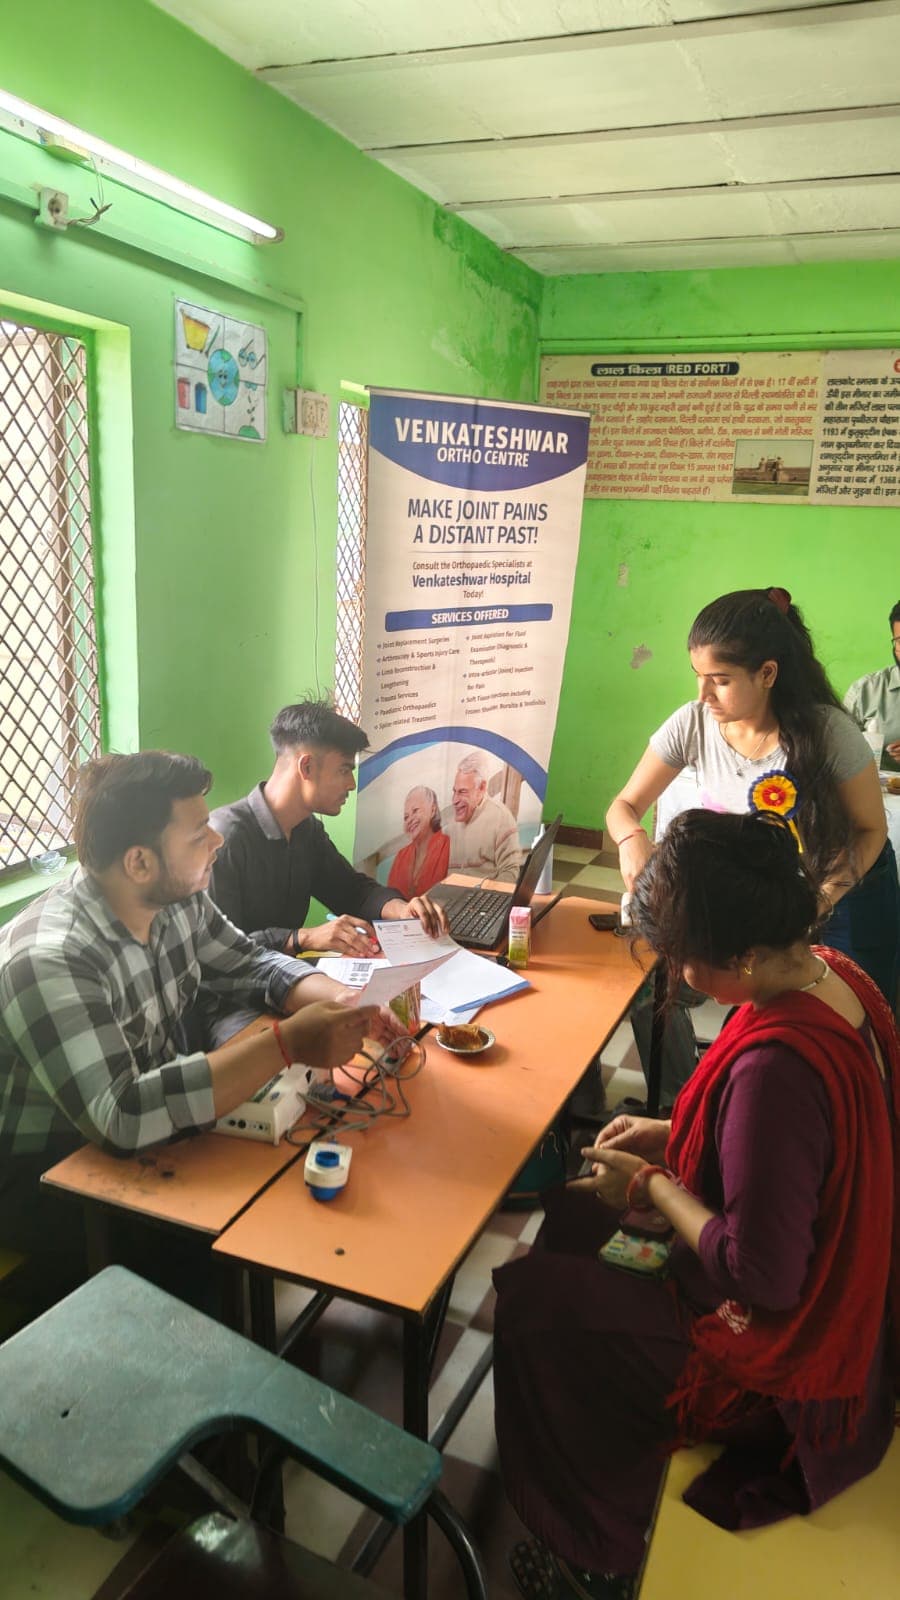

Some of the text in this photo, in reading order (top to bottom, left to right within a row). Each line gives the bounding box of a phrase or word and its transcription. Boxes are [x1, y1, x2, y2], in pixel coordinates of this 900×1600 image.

[597, 362, 730, 376] लाल किला (RED FORT)
[395, 417, 569, 454] VENKATESHWAR
[437, 447, 530, 468] ORTHO CENTRE
[408, 499, 548, 522] MAKE JOINT PAINS
[413, 524, 538, 544] A DISTANT PAST!
[412, 561, 440, 570] Consult
[440, 561, 450, 570] the
[452, 560, 490, 570] Orthopaedic
[492, 560, 526, 570] Specialists
[412, 570, 532, 588] Venkateshwar Hospital
[463, 590, 484, 599] Today!
[432, 609, 510, 624] SERVICES OFFERED
